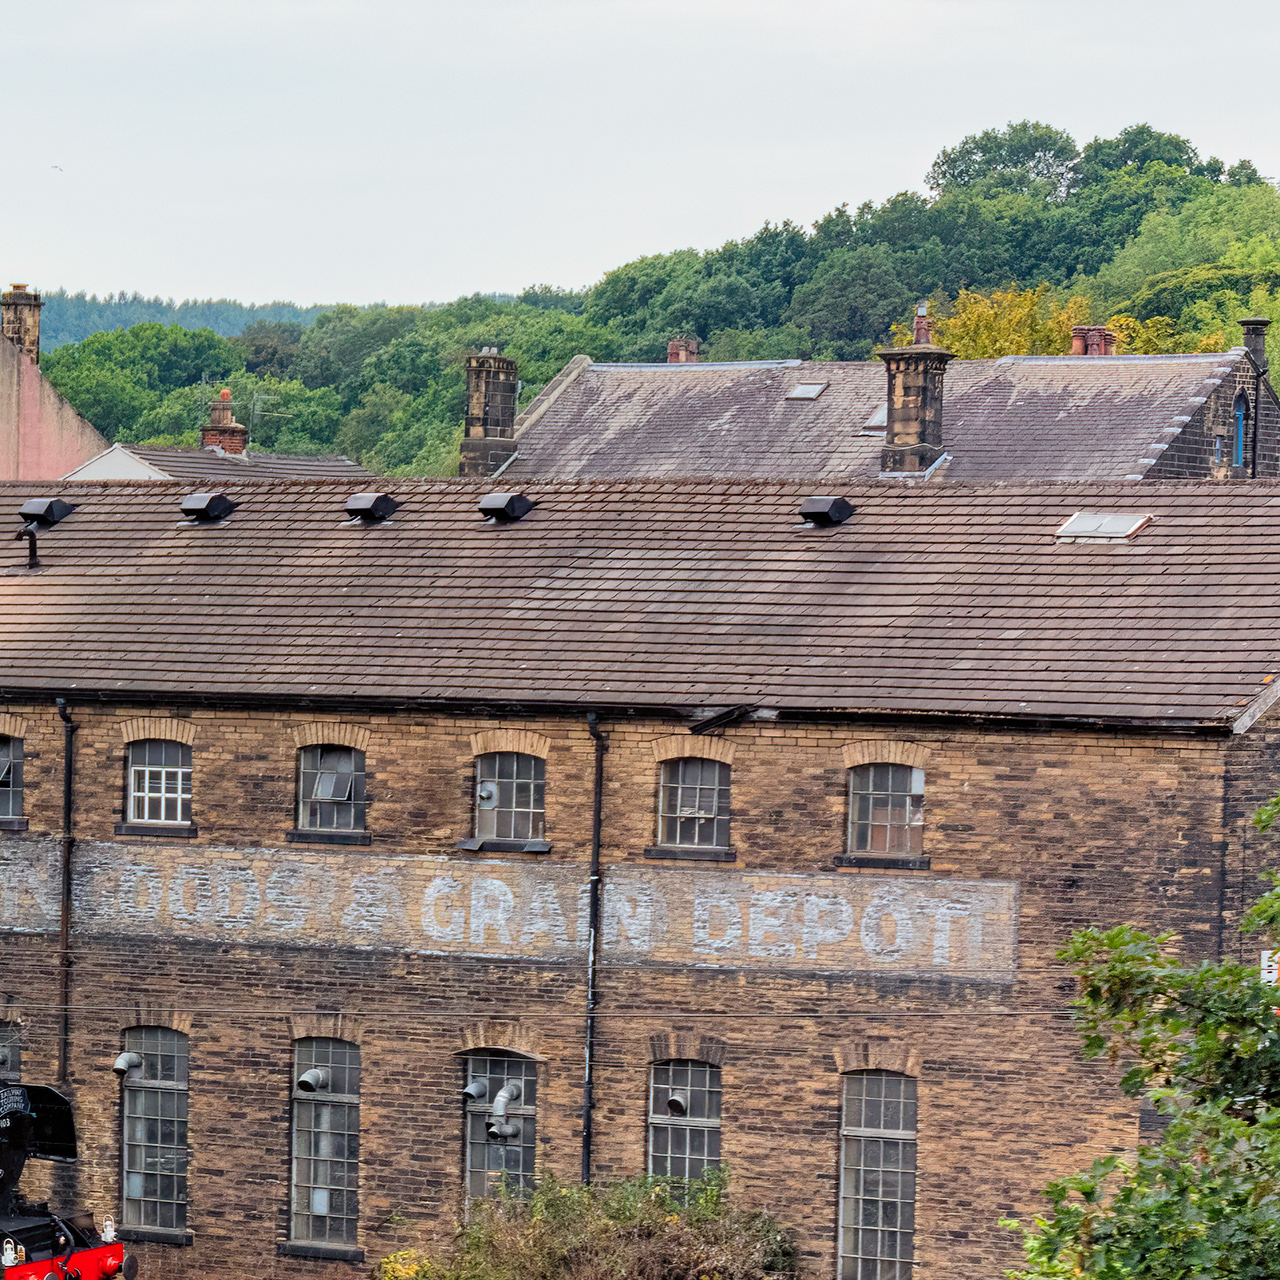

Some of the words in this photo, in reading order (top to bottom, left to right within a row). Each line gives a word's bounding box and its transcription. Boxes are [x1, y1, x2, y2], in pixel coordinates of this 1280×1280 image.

[421, 868, 662, 952] GRAIN
[692, 887, 983, 967] DEPOT
[0, 1102, 25, 1113] COMPANY
